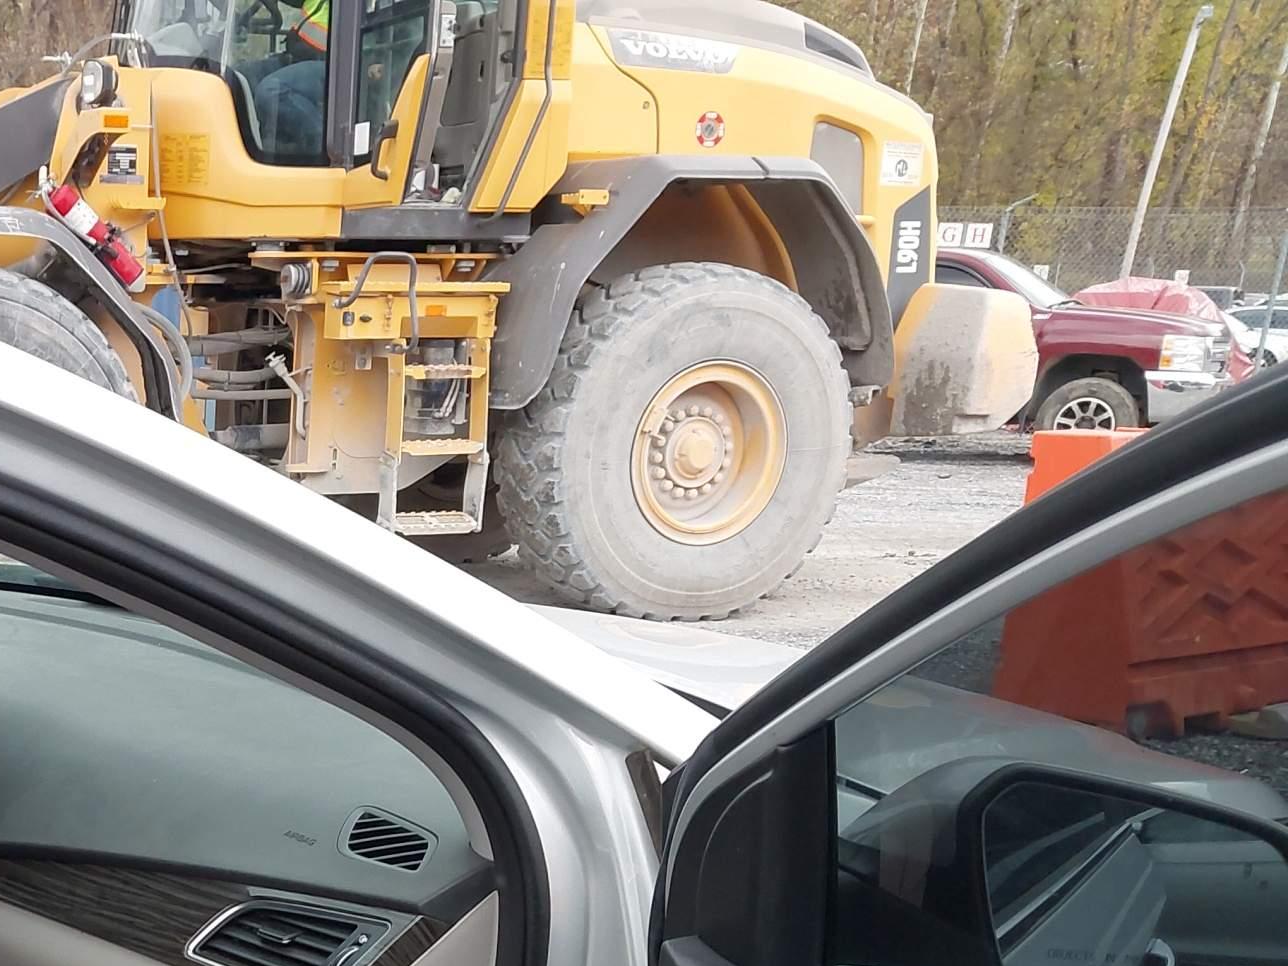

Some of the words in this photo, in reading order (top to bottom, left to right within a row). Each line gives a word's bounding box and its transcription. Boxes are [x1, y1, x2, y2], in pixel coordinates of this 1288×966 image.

[942, 226, 957, 243] G
[972, 226, 987, 243] H
[895, 220, 921, 273] L90H
